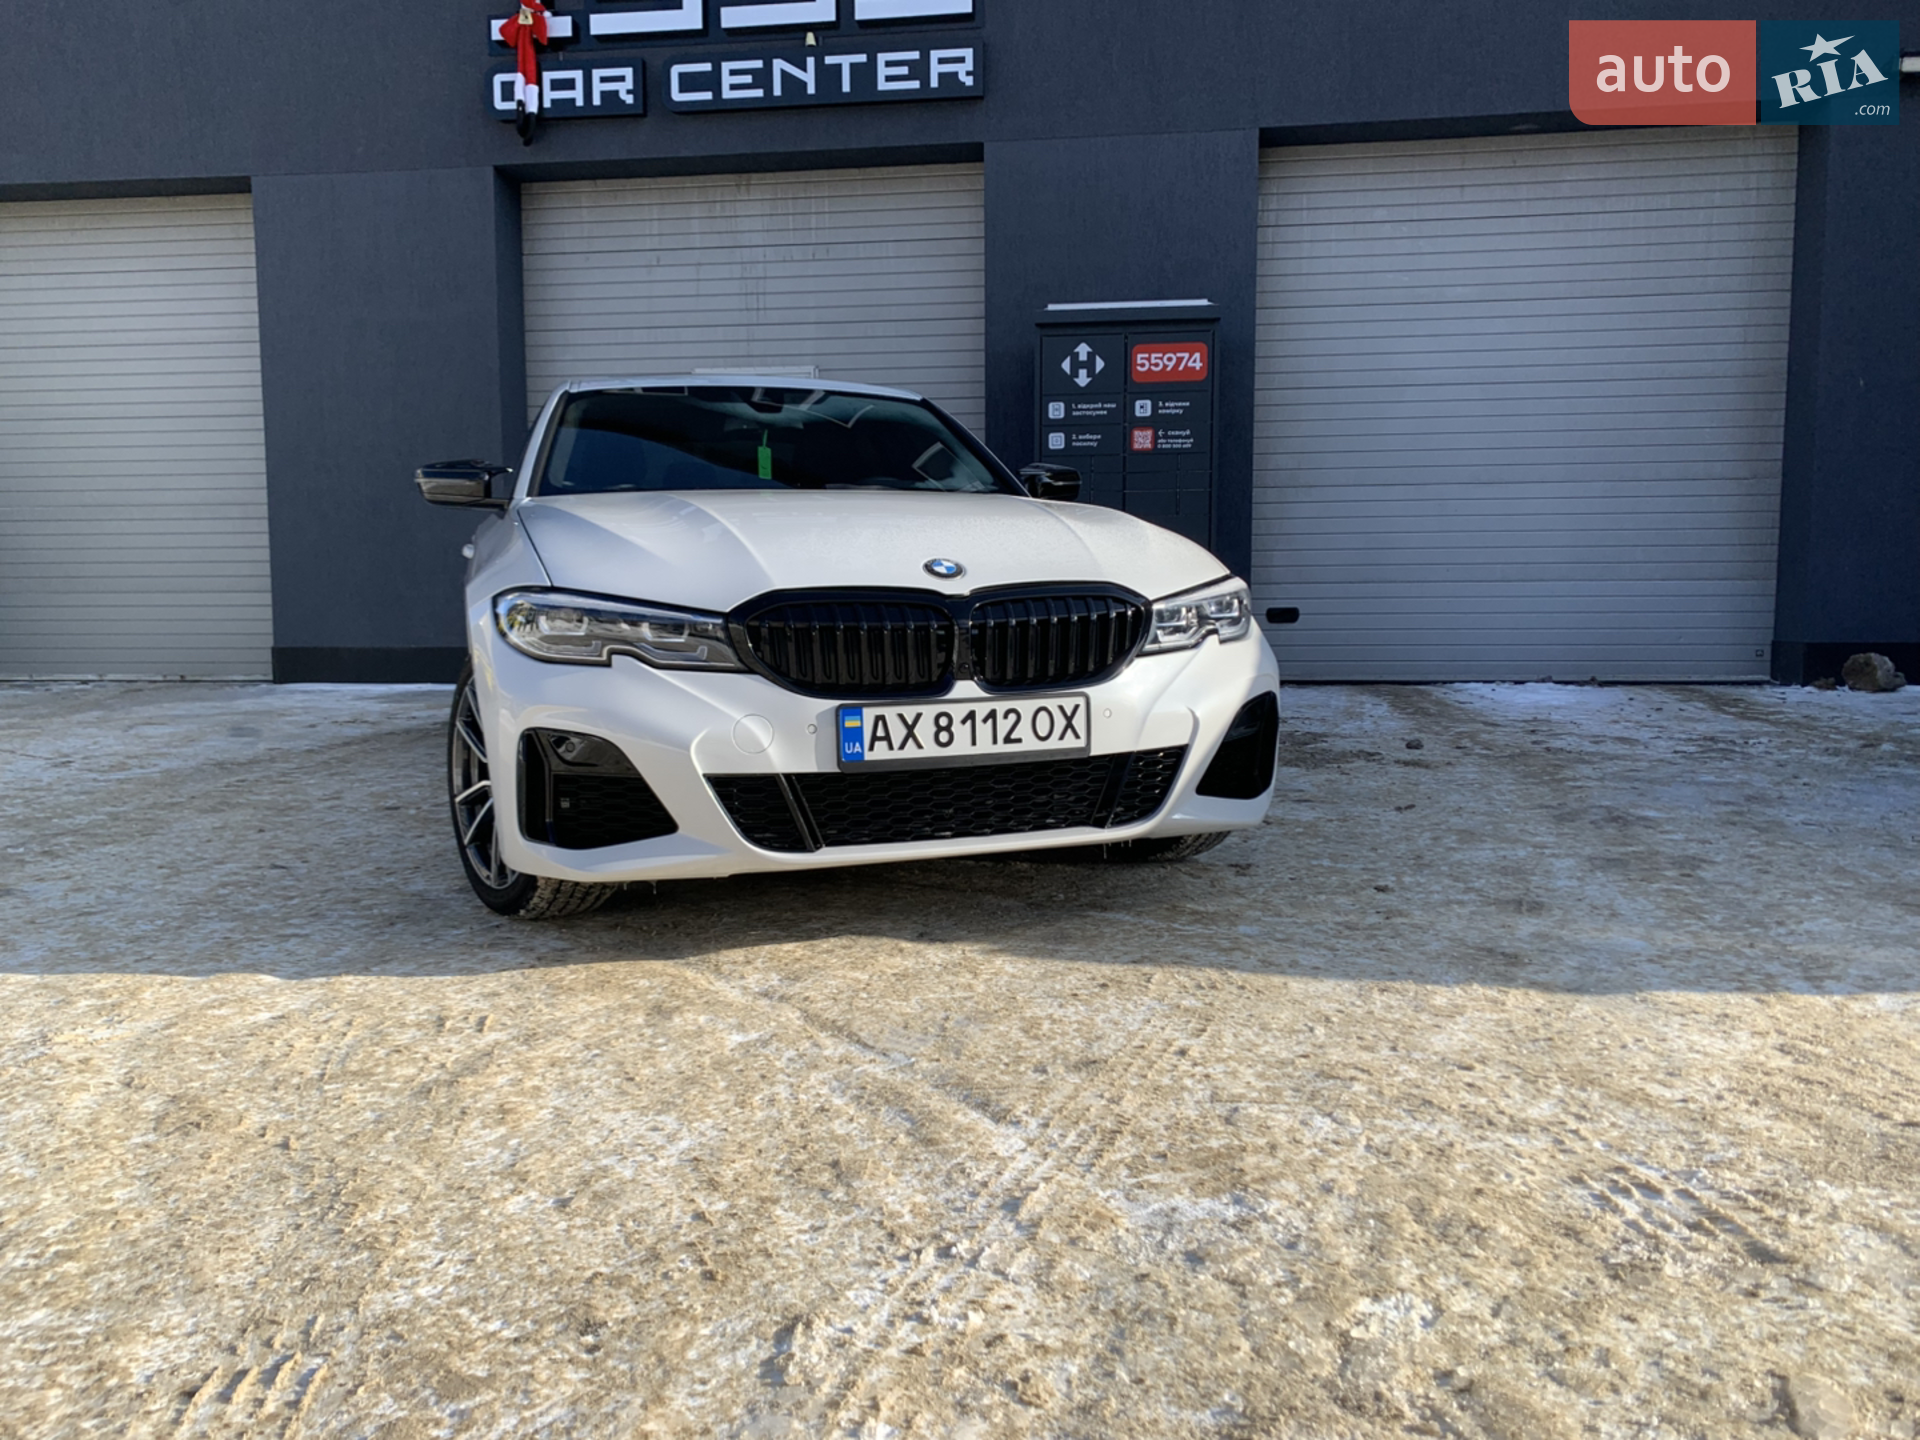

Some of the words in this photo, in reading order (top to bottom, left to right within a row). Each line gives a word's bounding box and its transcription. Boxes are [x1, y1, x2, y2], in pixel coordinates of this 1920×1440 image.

[670, 47, 974, 101] CENTER
[1136, 352, 1203, 372] 55974
[845, 742, 862, 754] UA
